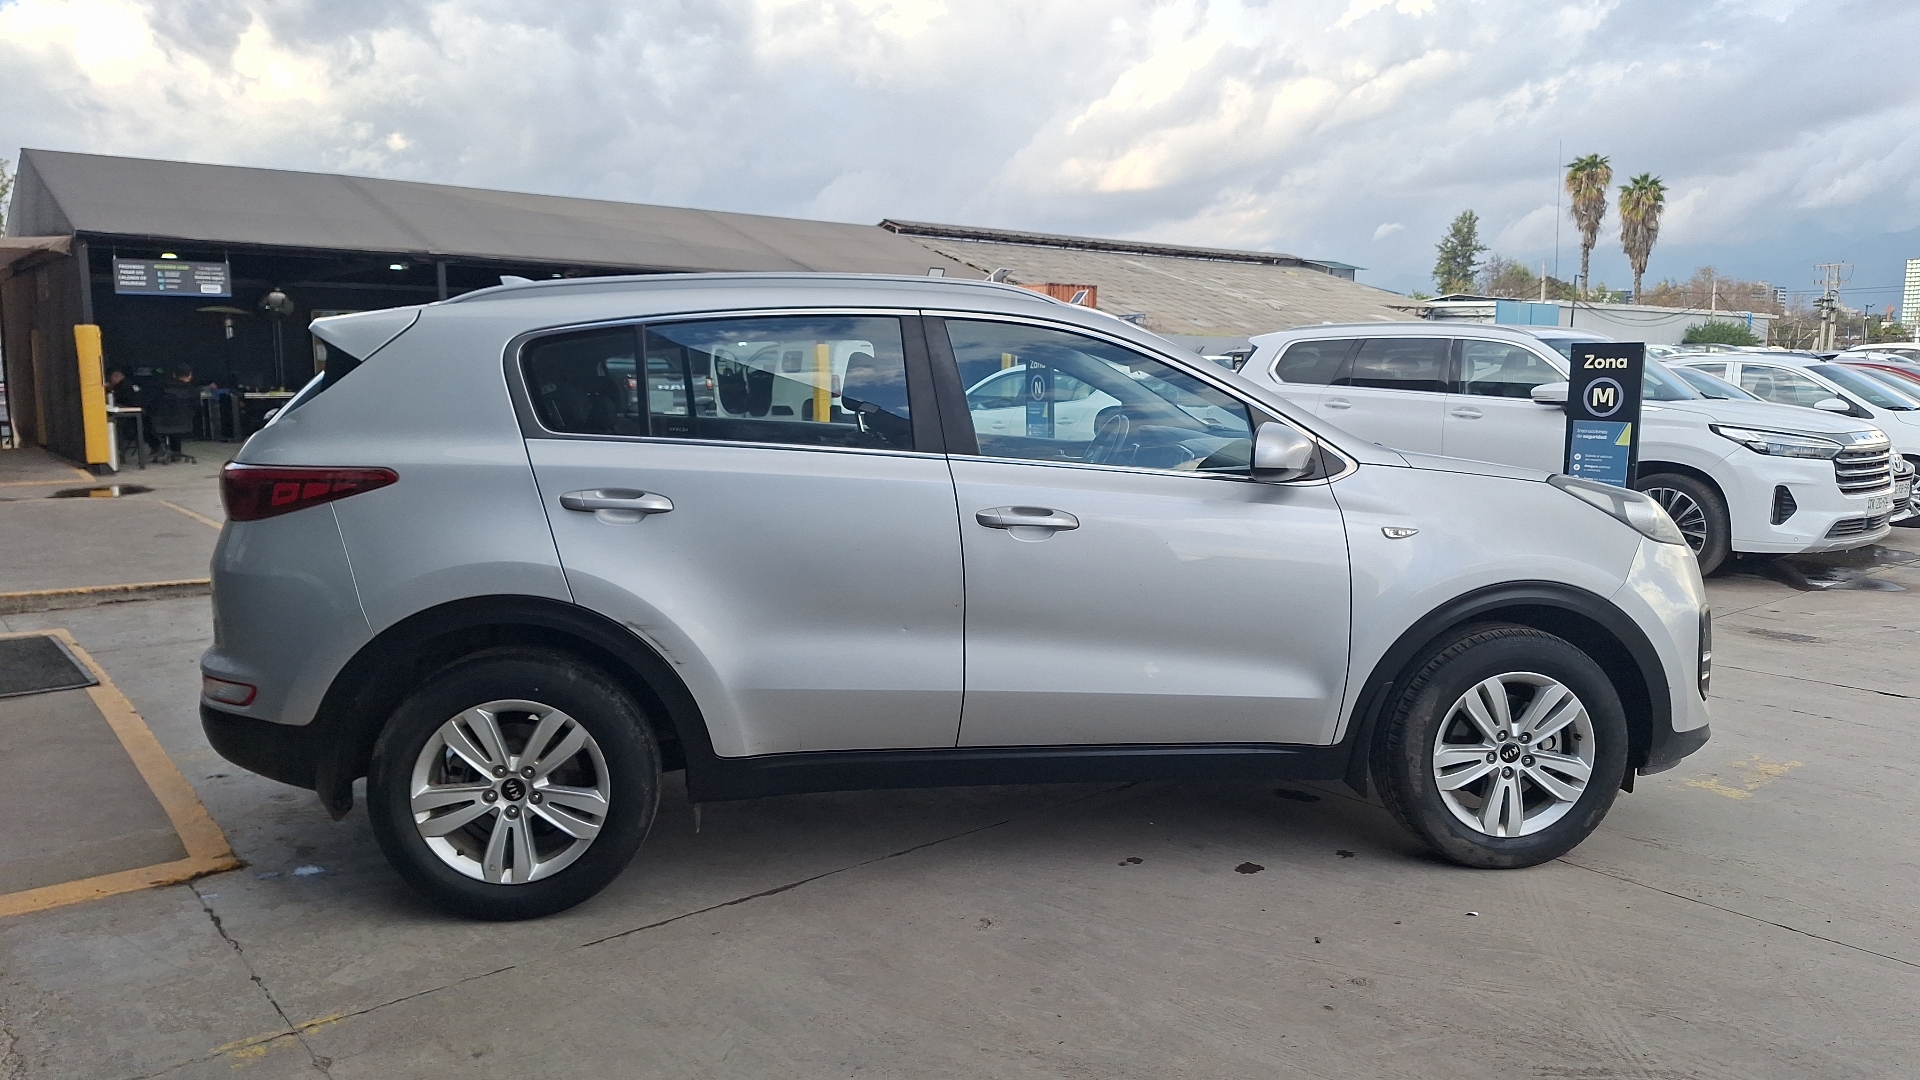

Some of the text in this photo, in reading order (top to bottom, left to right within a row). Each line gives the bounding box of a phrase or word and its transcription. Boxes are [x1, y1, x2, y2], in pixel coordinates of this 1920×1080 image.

[1583, 354, 1628, 369] Zona
[1034, 381, 1042, 394] N
[1592, 387, 1615, 407] M
[1502, 746, 1519, 759] KIA
[506, 780, 521, 799] KIA
